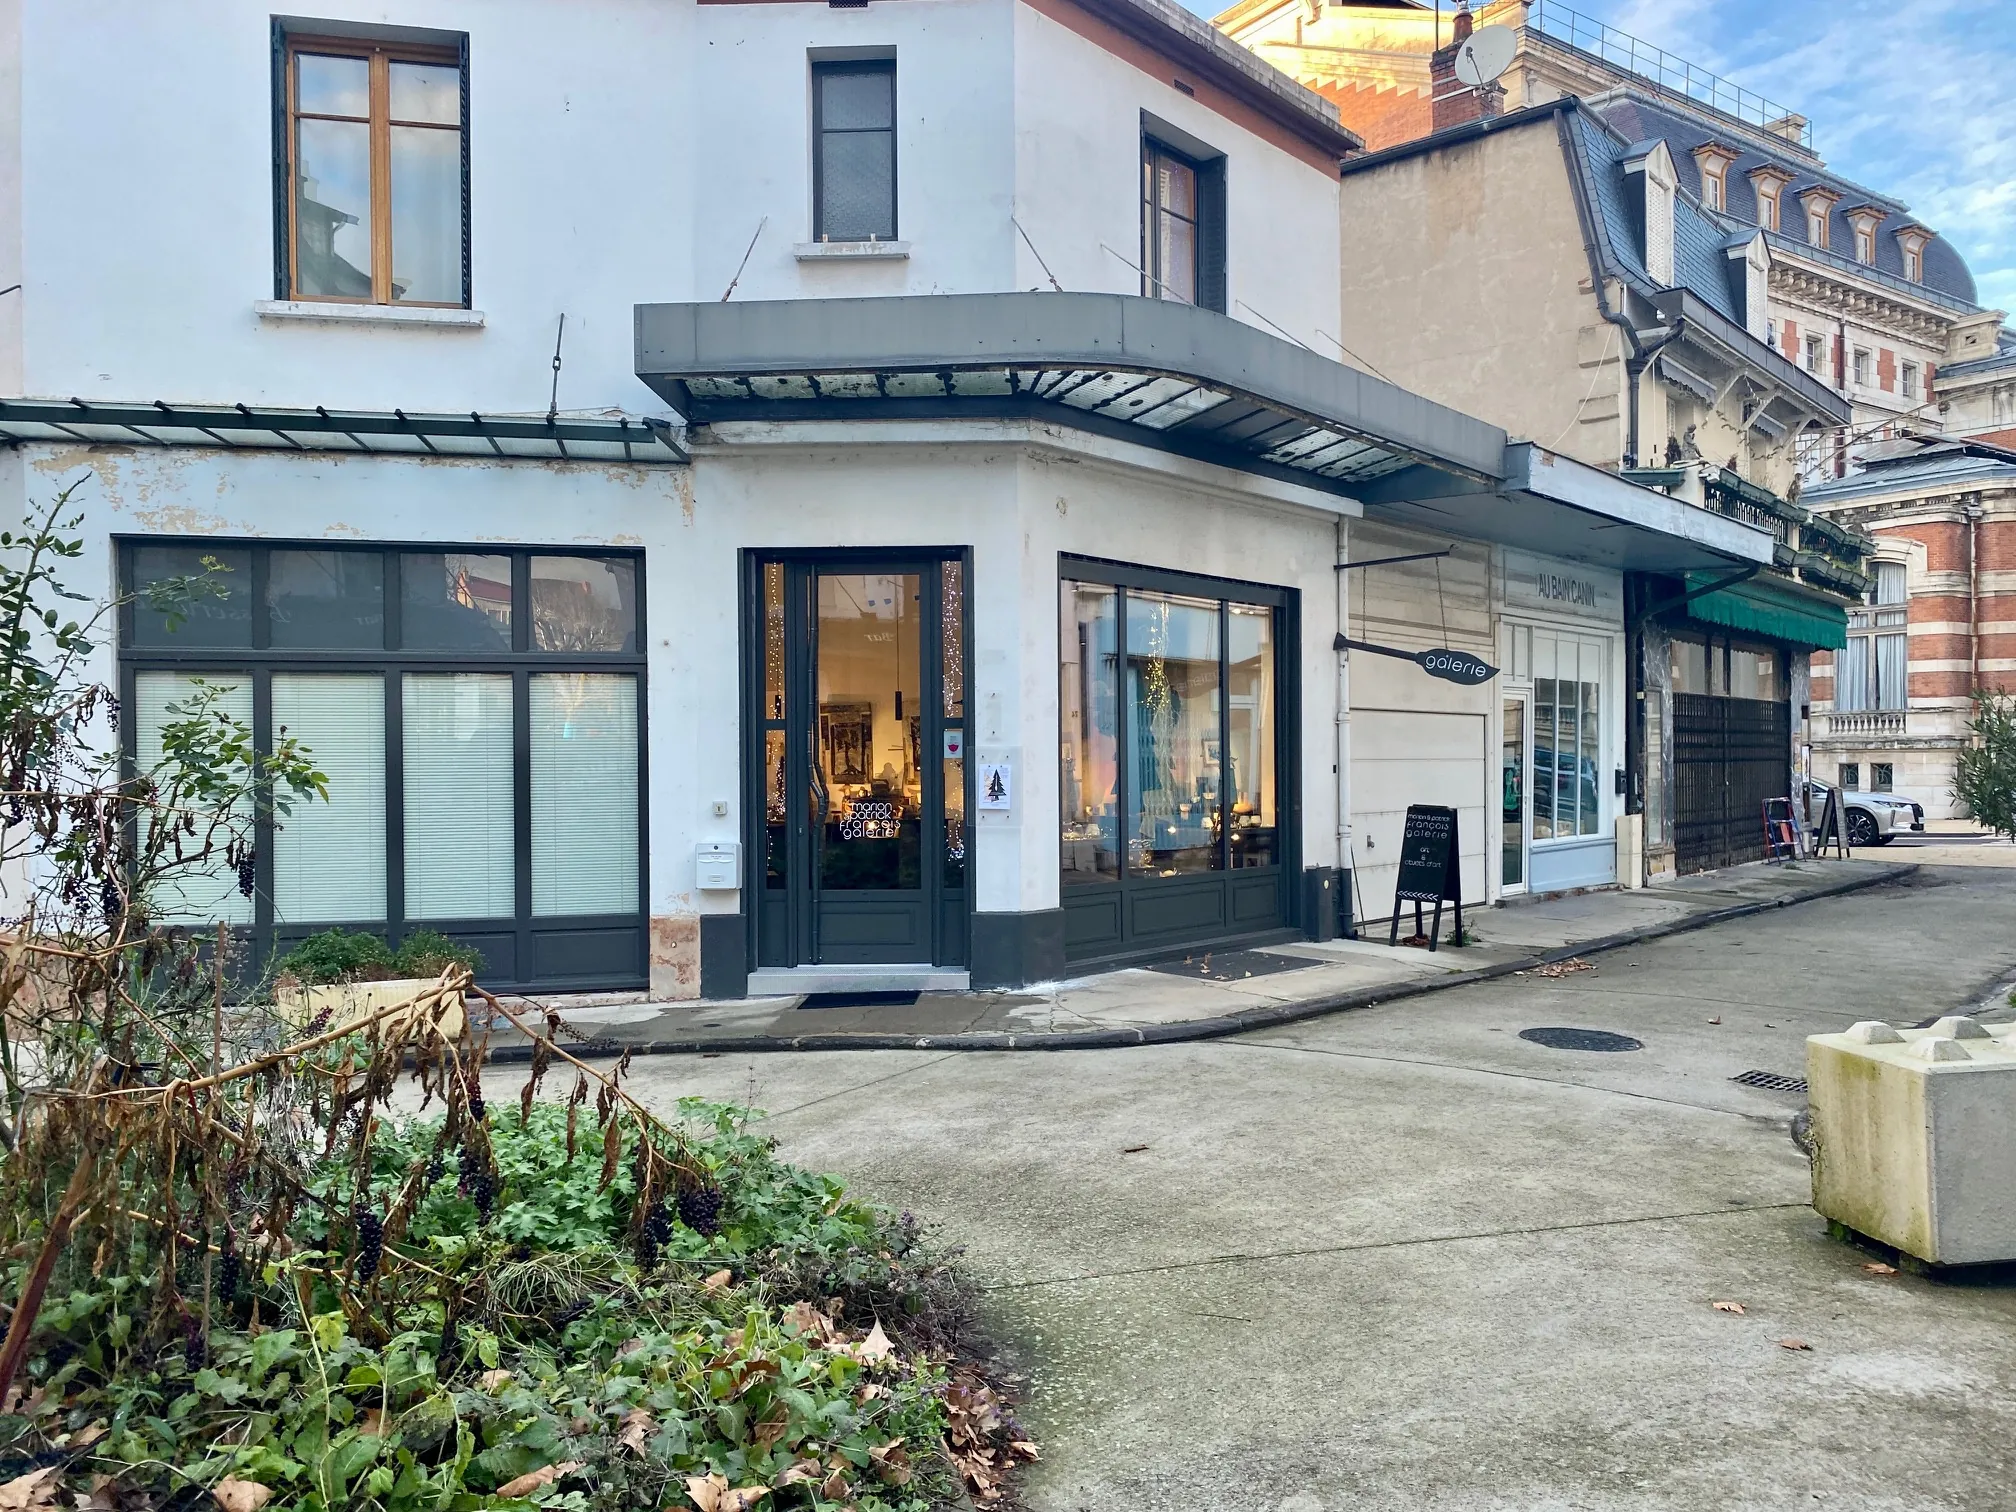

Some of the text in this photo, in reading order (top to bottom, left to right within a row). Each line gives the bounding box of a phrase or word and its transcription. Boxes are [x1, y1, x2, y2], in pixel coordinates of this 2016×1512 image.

[1538, 573, 1551, 599] AU
[1425, 655, 1487, 677] galerie
[851, 802, 893, 811] marion
[849, 809, 892, 822] patrick
[1406, 820, 1449, 831] françois
[843, 828, 894, 840] galerie
[1405, 829, 1448, 839] galerie
